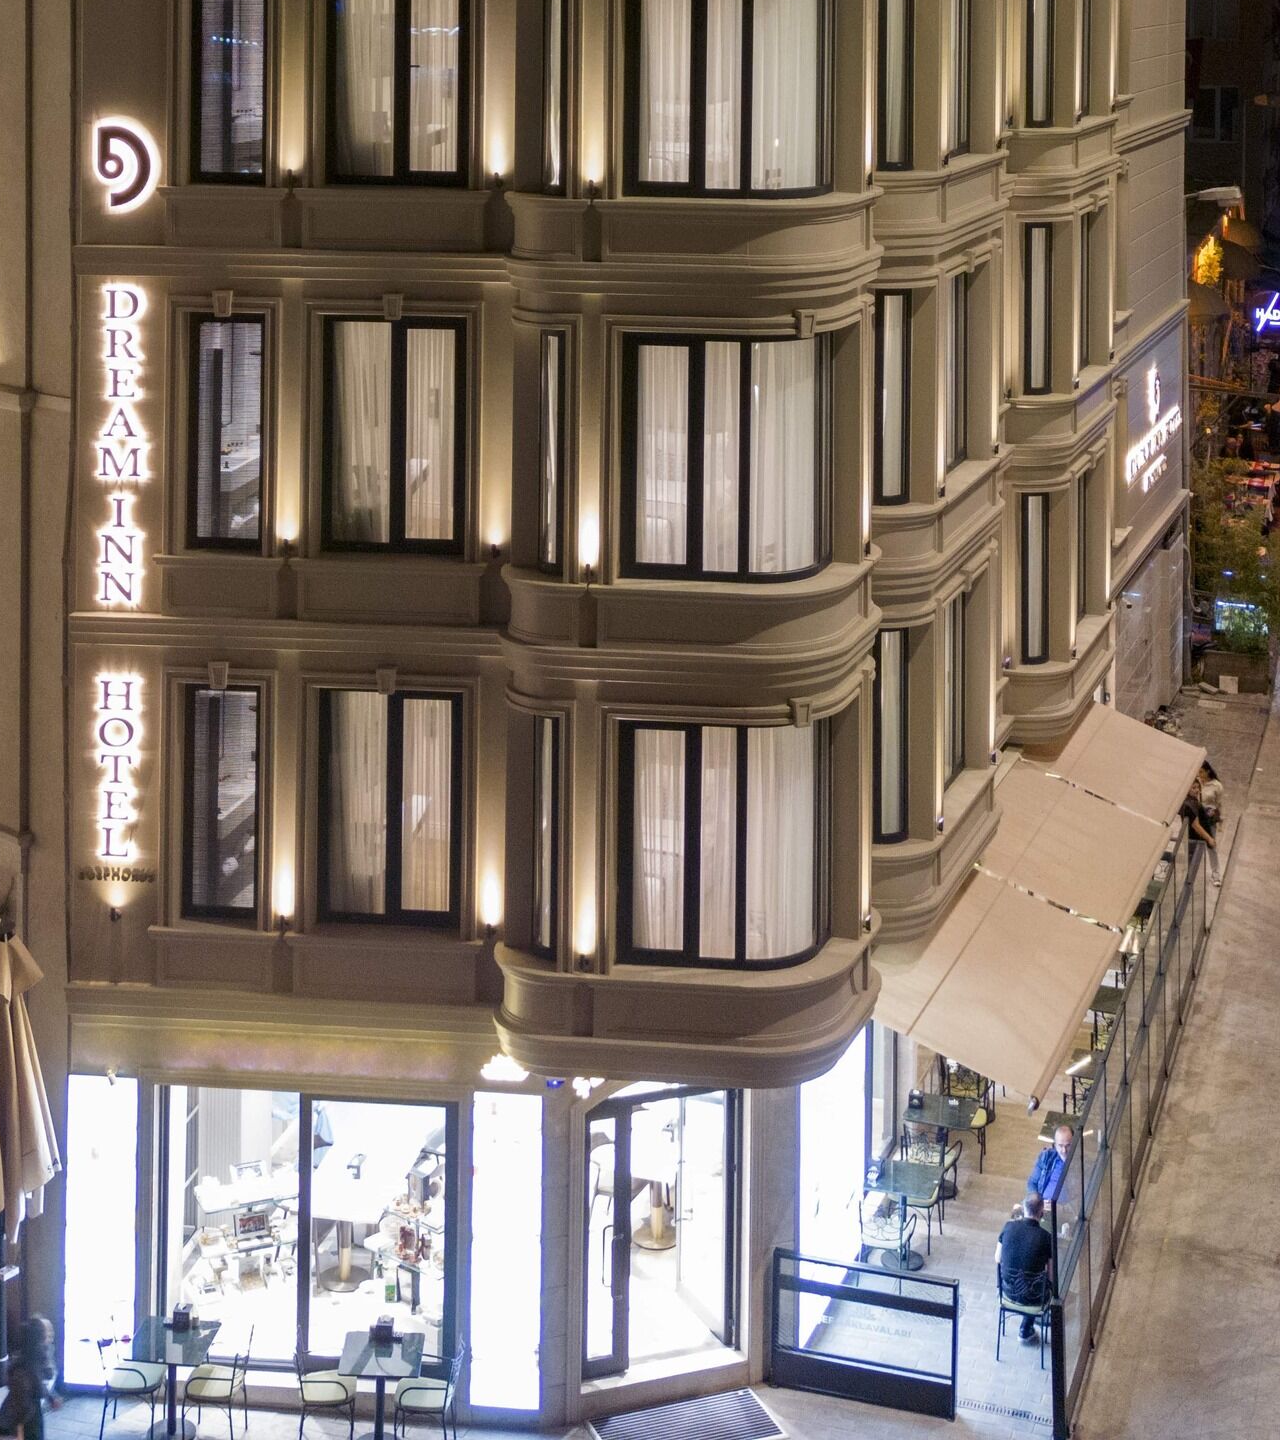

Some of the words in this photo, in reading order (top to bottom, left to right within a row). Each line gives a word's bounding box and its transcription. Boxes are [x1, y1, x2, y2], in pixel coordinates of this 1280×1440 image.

[98, 289, 141, 478] DREAM
[100, 498, 136, 601] INN
[98, 680, 134, 858] HOTEL
